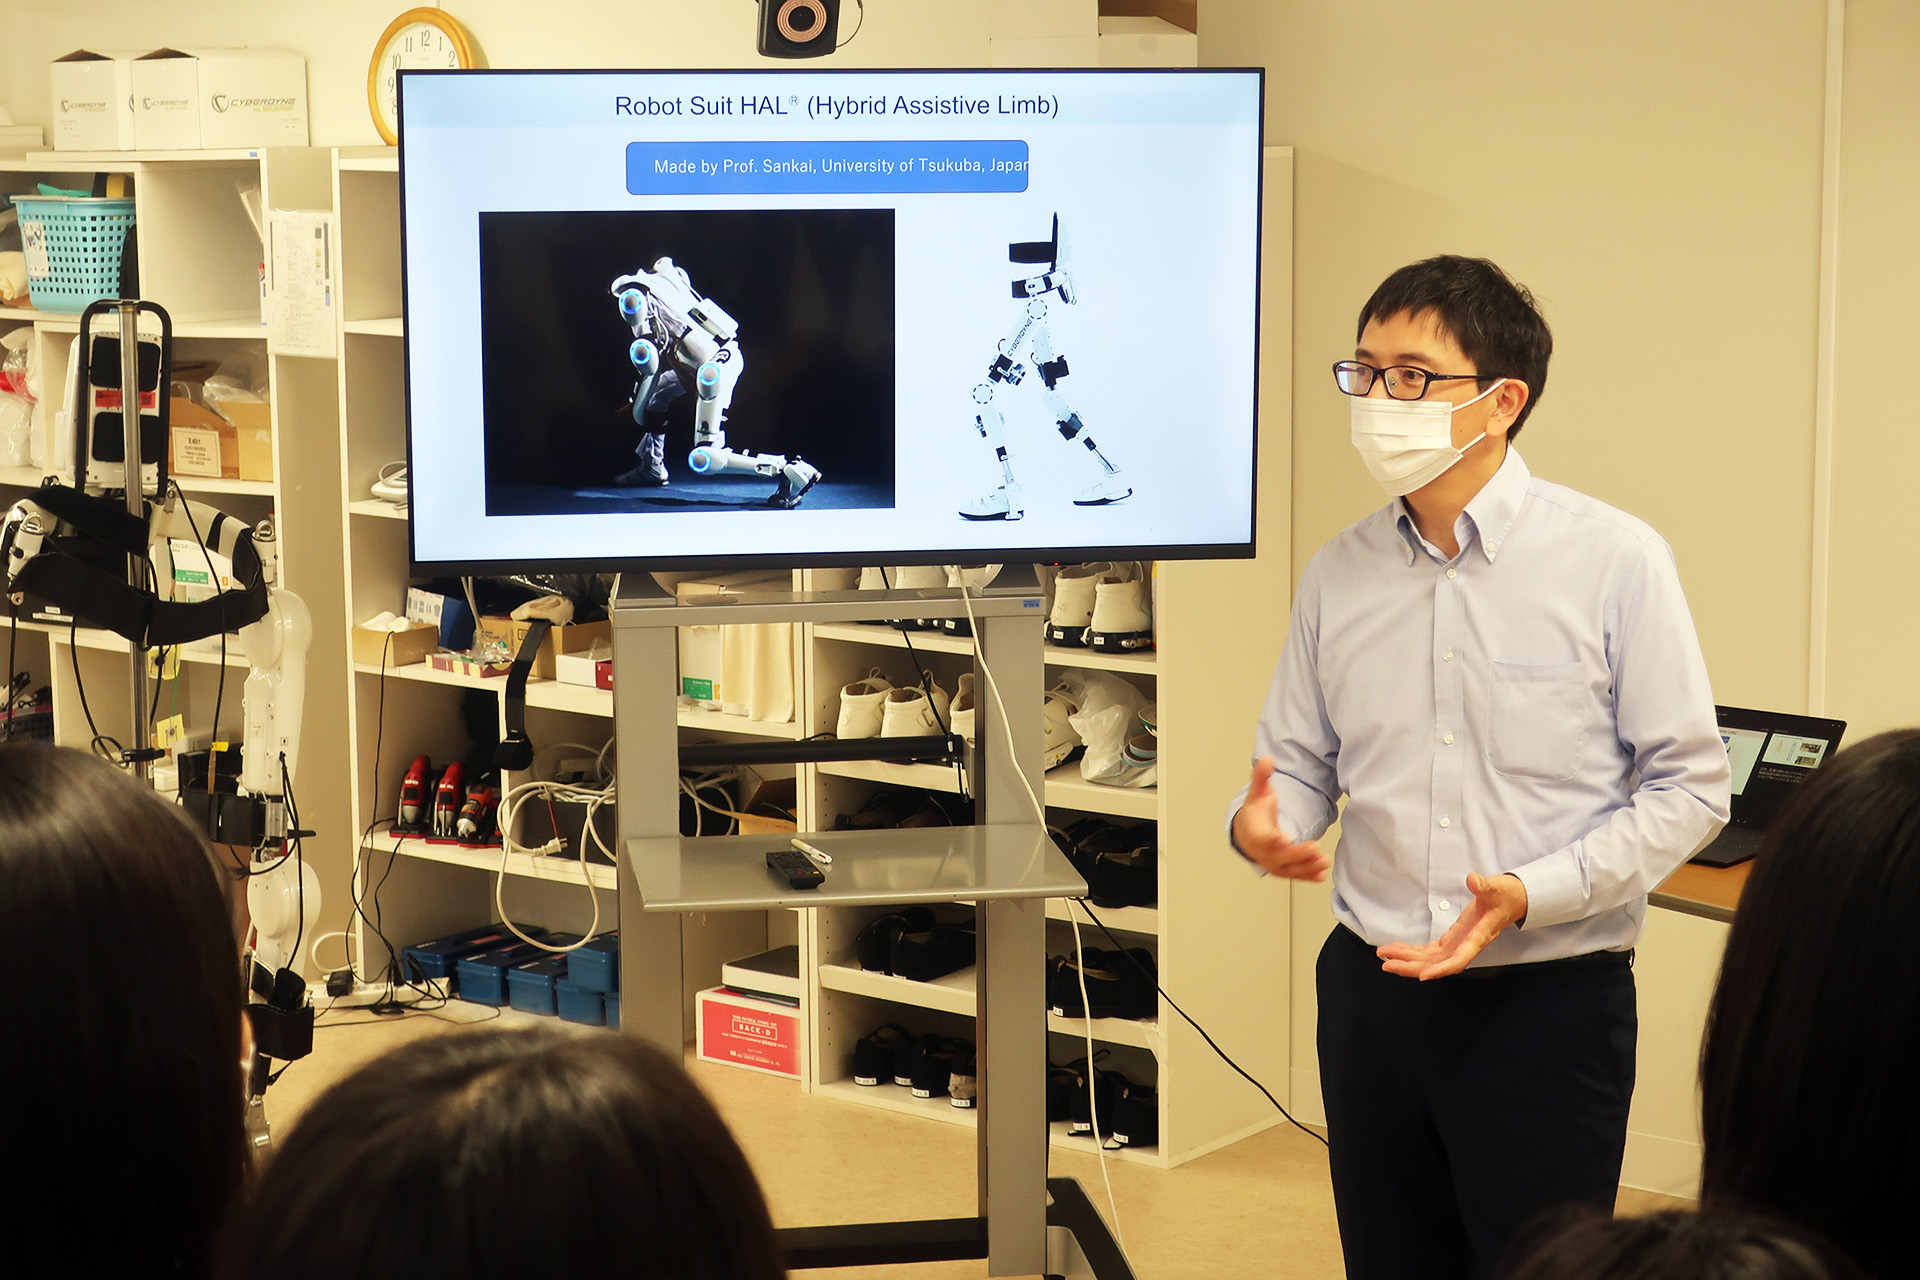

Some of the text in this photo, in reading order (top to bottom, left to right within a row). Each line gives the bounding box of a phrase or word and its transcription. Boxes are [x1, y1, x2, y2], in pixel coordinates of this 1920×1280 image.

[405, 37, 413, 52] 11
[420, 29, 430, 47] 12
[392, 53, 401, 70] 10
[448, 50, 456, 67] 2
[387, 76, 394, 93] 9
[230, 97, 296, 107] CYBERDYNE
[615, 96, 683, 116] Robot
[690, 95, 733, 116] Suit
[807, 94, 886, 120] (Hybrid
[892, 94, 990, 116] Assistive
[998, 94, 1060, 120] Limb)
[654, 159, 696, 175] Made
[701, 159, 720, 177] by
[724, 158, 758, 174] Prof.
[763, 158, 818, 176] Sankai,
[822, 157, 895, 177] University
[899, 157, 915, 174] of
[918, 157, 986, 175] Tsukuba,
